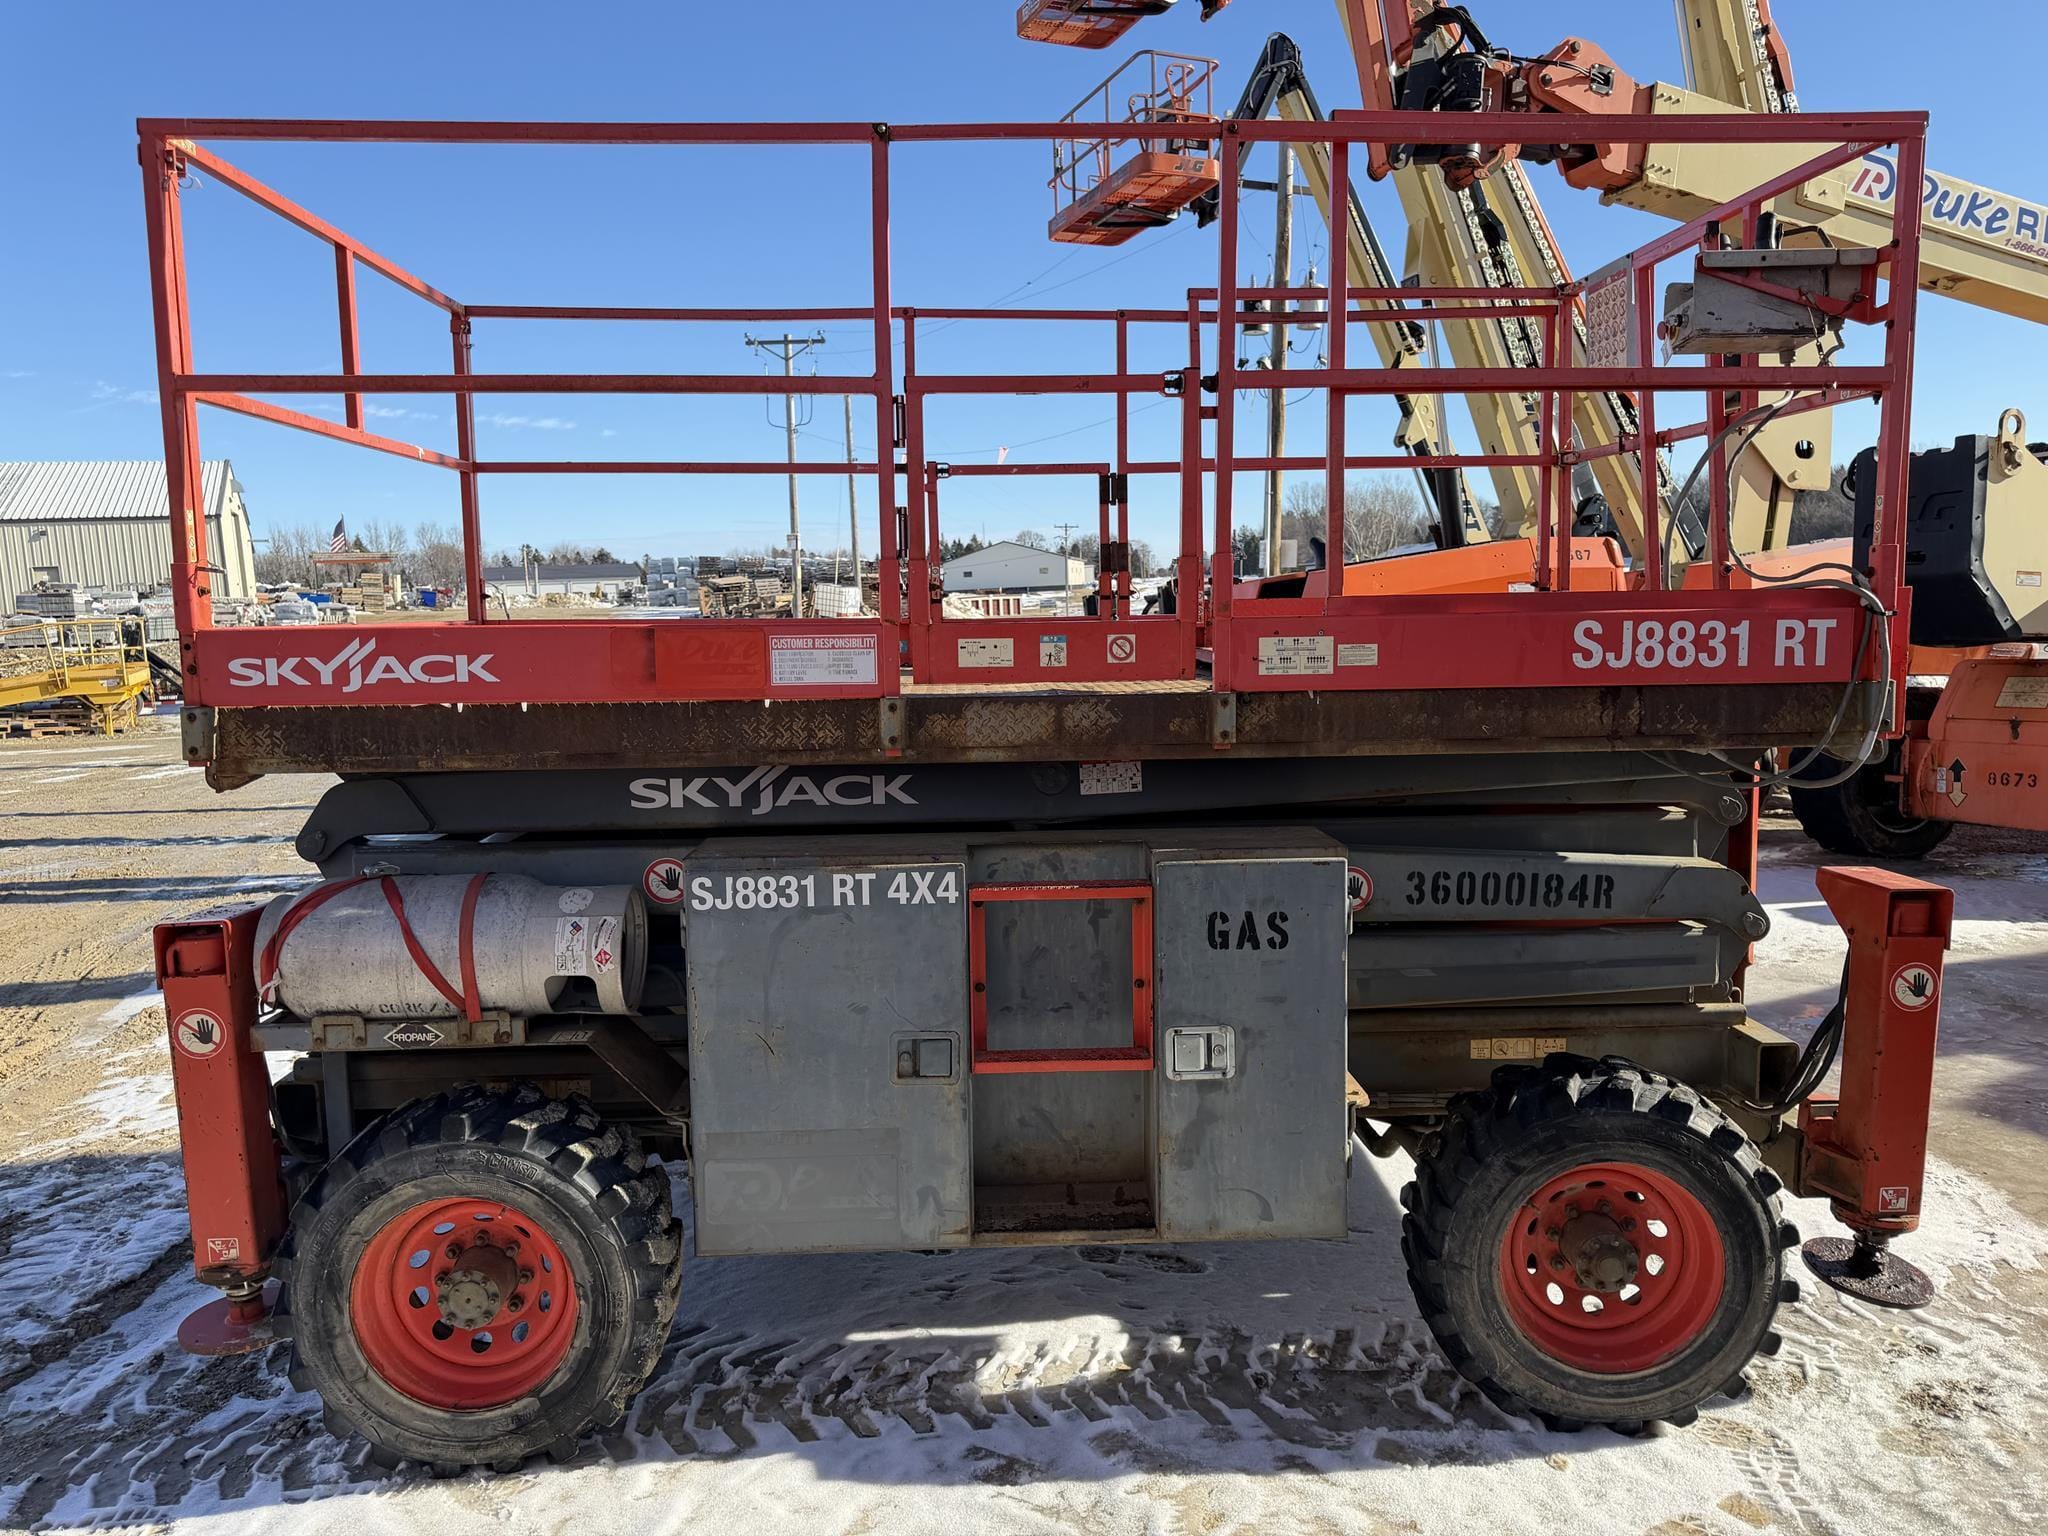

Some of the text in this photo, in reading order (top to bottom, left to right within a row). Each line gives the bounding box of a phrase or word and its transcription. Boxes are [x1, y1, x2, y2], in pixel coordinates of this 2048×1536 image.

[772, 637, 875, 649] CUSTOMER RESPONSIBILITY
[1572, 619, 1838, 669] SJ8831 RT
[228, 637, 500, 692] SKYJACK
[629, 765, 919, 815] SKYJACK
[1987, 771, 2038, 789] 8673
[691, 871, 959, 911] SJ8831 RT 4X4
[1405, 870, 1615, 910] 36000184R
[1206, 911, 1291, 951] GAS
[392, 1032, 436, 1043] PROPANE
